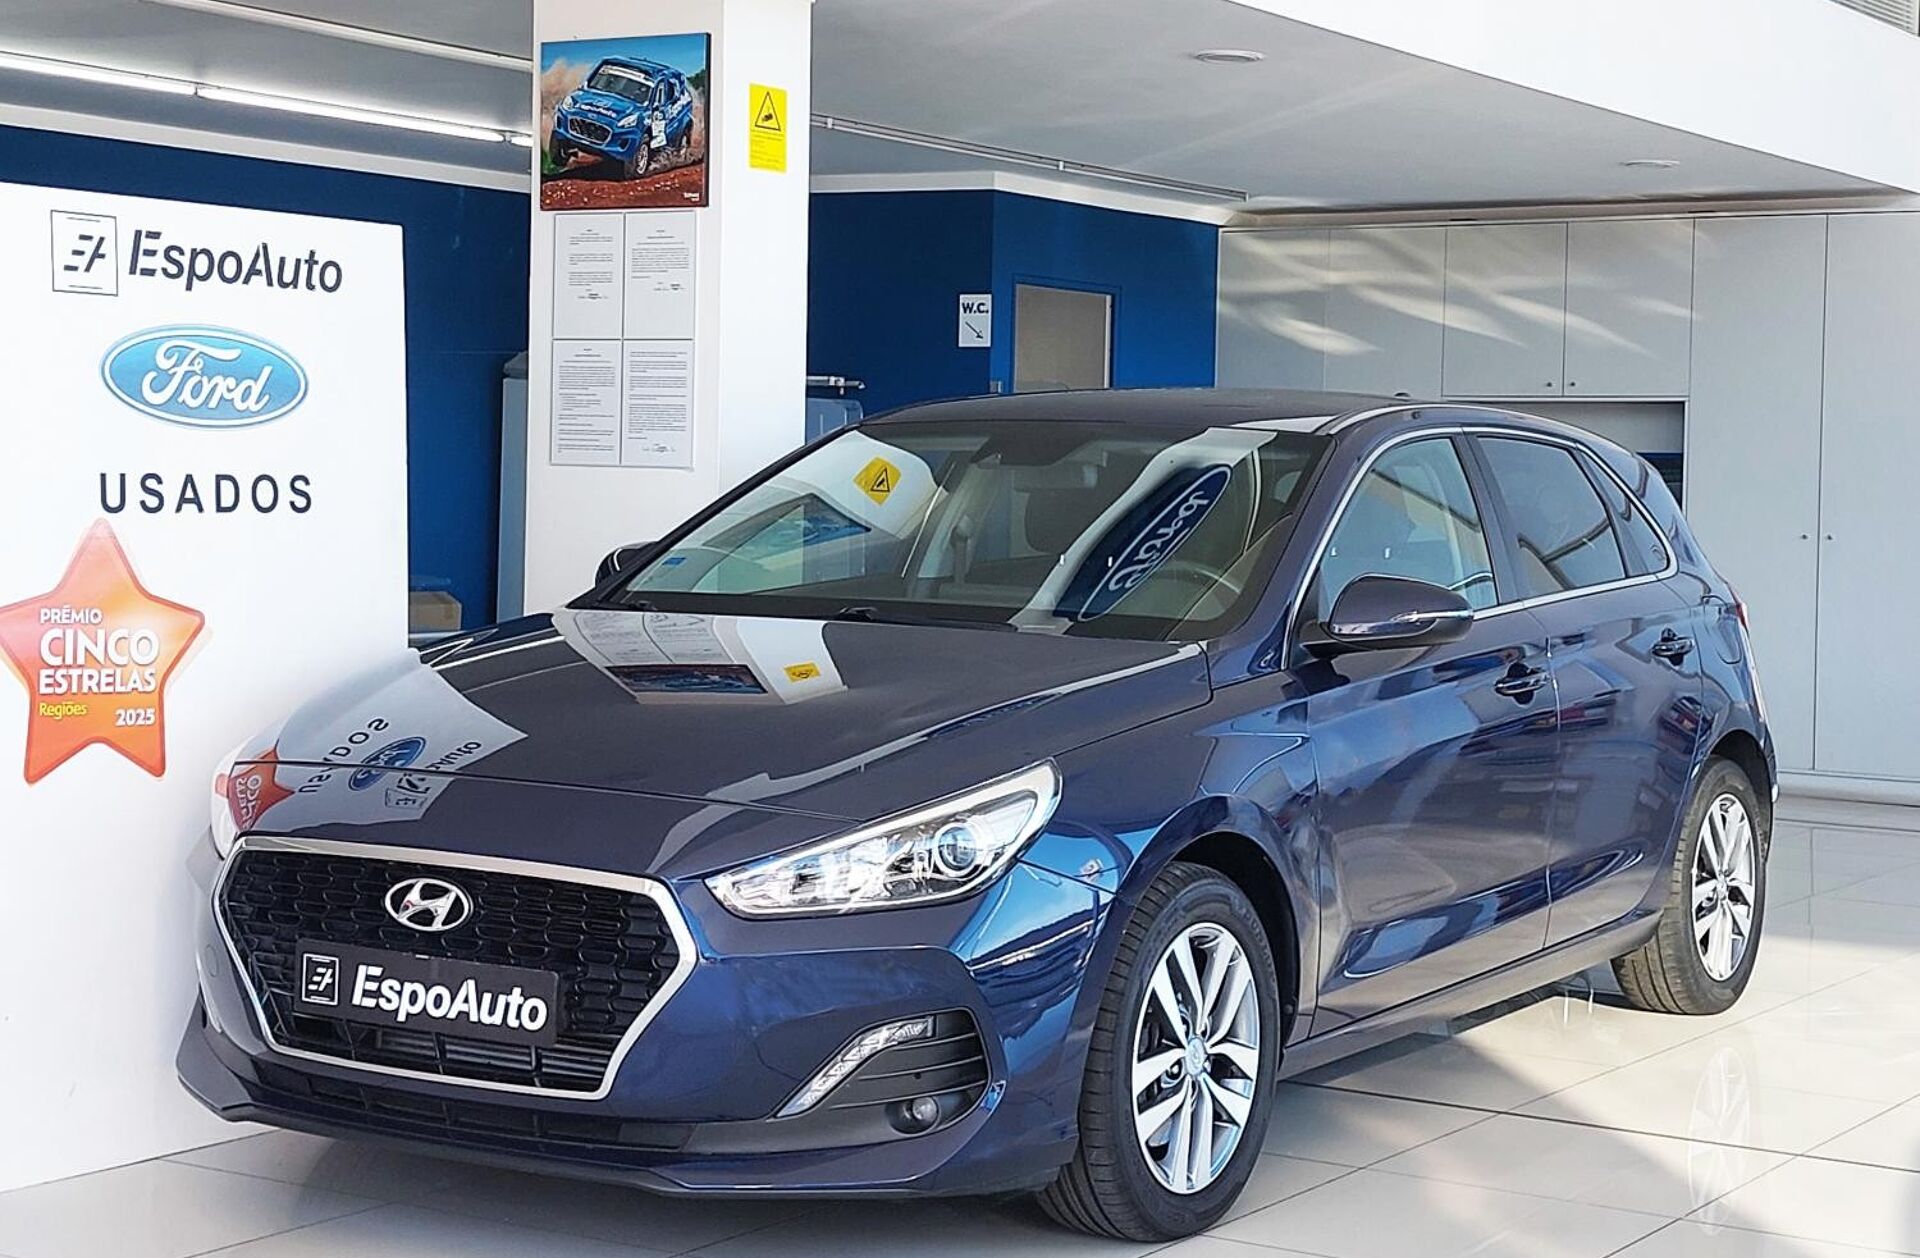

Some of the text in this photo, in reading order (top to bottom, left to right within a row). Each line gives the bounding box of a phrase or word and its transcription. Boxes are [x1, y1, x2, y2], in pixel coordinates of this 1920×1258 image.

[128, 229, 343, 293] EspoAuto
[961, 302, 990, 314] W.C.
[141, 339, 273, 412] Ford
[100, 472, 312, 514] USADOS
[40, 605, 103, 625] PRÉMIO
[40, 627, 160, 667] CINCO
[40, 668, 156, 695] ESTRELAS
[40, 702, 156, 727] Regiões 2025
[352, 964, 548, 1032] EspoAuto
